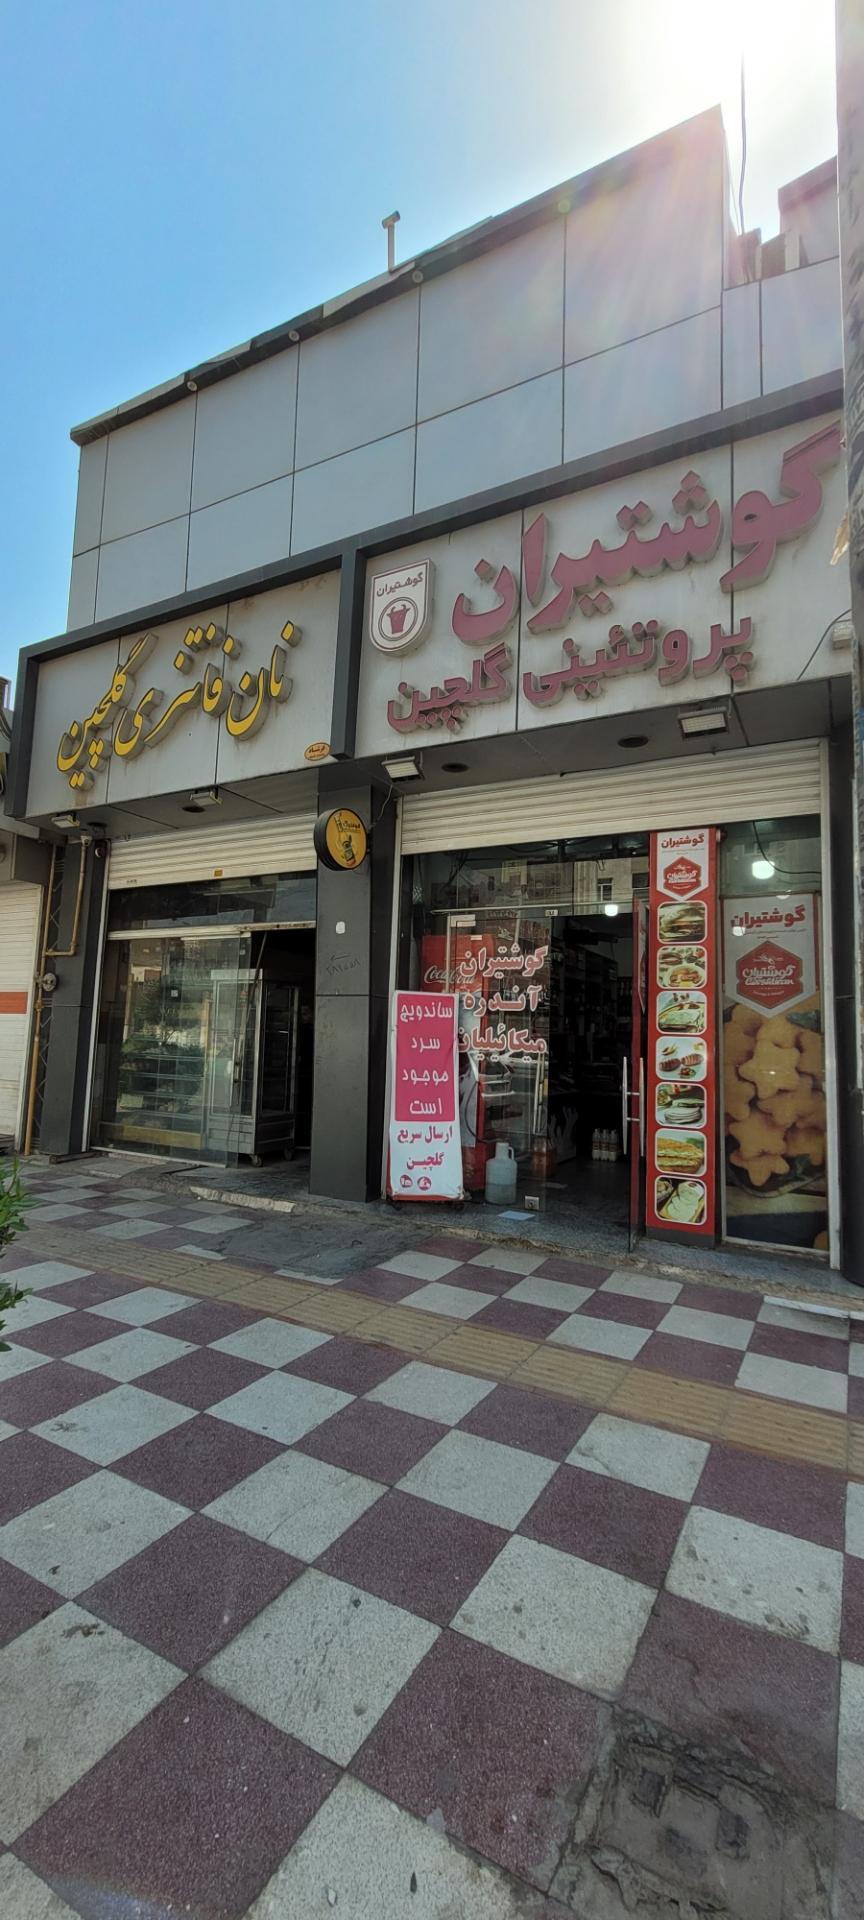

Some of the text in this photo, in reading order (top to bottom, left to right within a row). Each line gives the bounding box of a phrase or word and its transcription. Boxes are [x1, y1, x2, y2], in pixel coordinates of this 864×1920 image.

[452, 420, 842, 646] گوشتیران
[376, 571, 424, 597] گوشتیران
[522, 616, 754, 708] پروتئینی
[387, 642, 512, 734] گلچین
[57, 620, 301, 790] نان فانتزی گلچین
[661, 832, 705, 849] گوشتیران
[730, 903, 806, 929] گوشتیران
[459, 942, 549, 979] گوشتیران
[400, 1001, 453, 1023] ساندویچ
[463, 984, 542, 1017] آندره
[411, 1036, 441, 1053] سرد
[402, 1068, 449, 1087] موجود
[409, 1098, 443, 1115] است
[397, 1126, 453, 1144] ارسال سریع
[406, 1152, 445, 1171] گلچین
